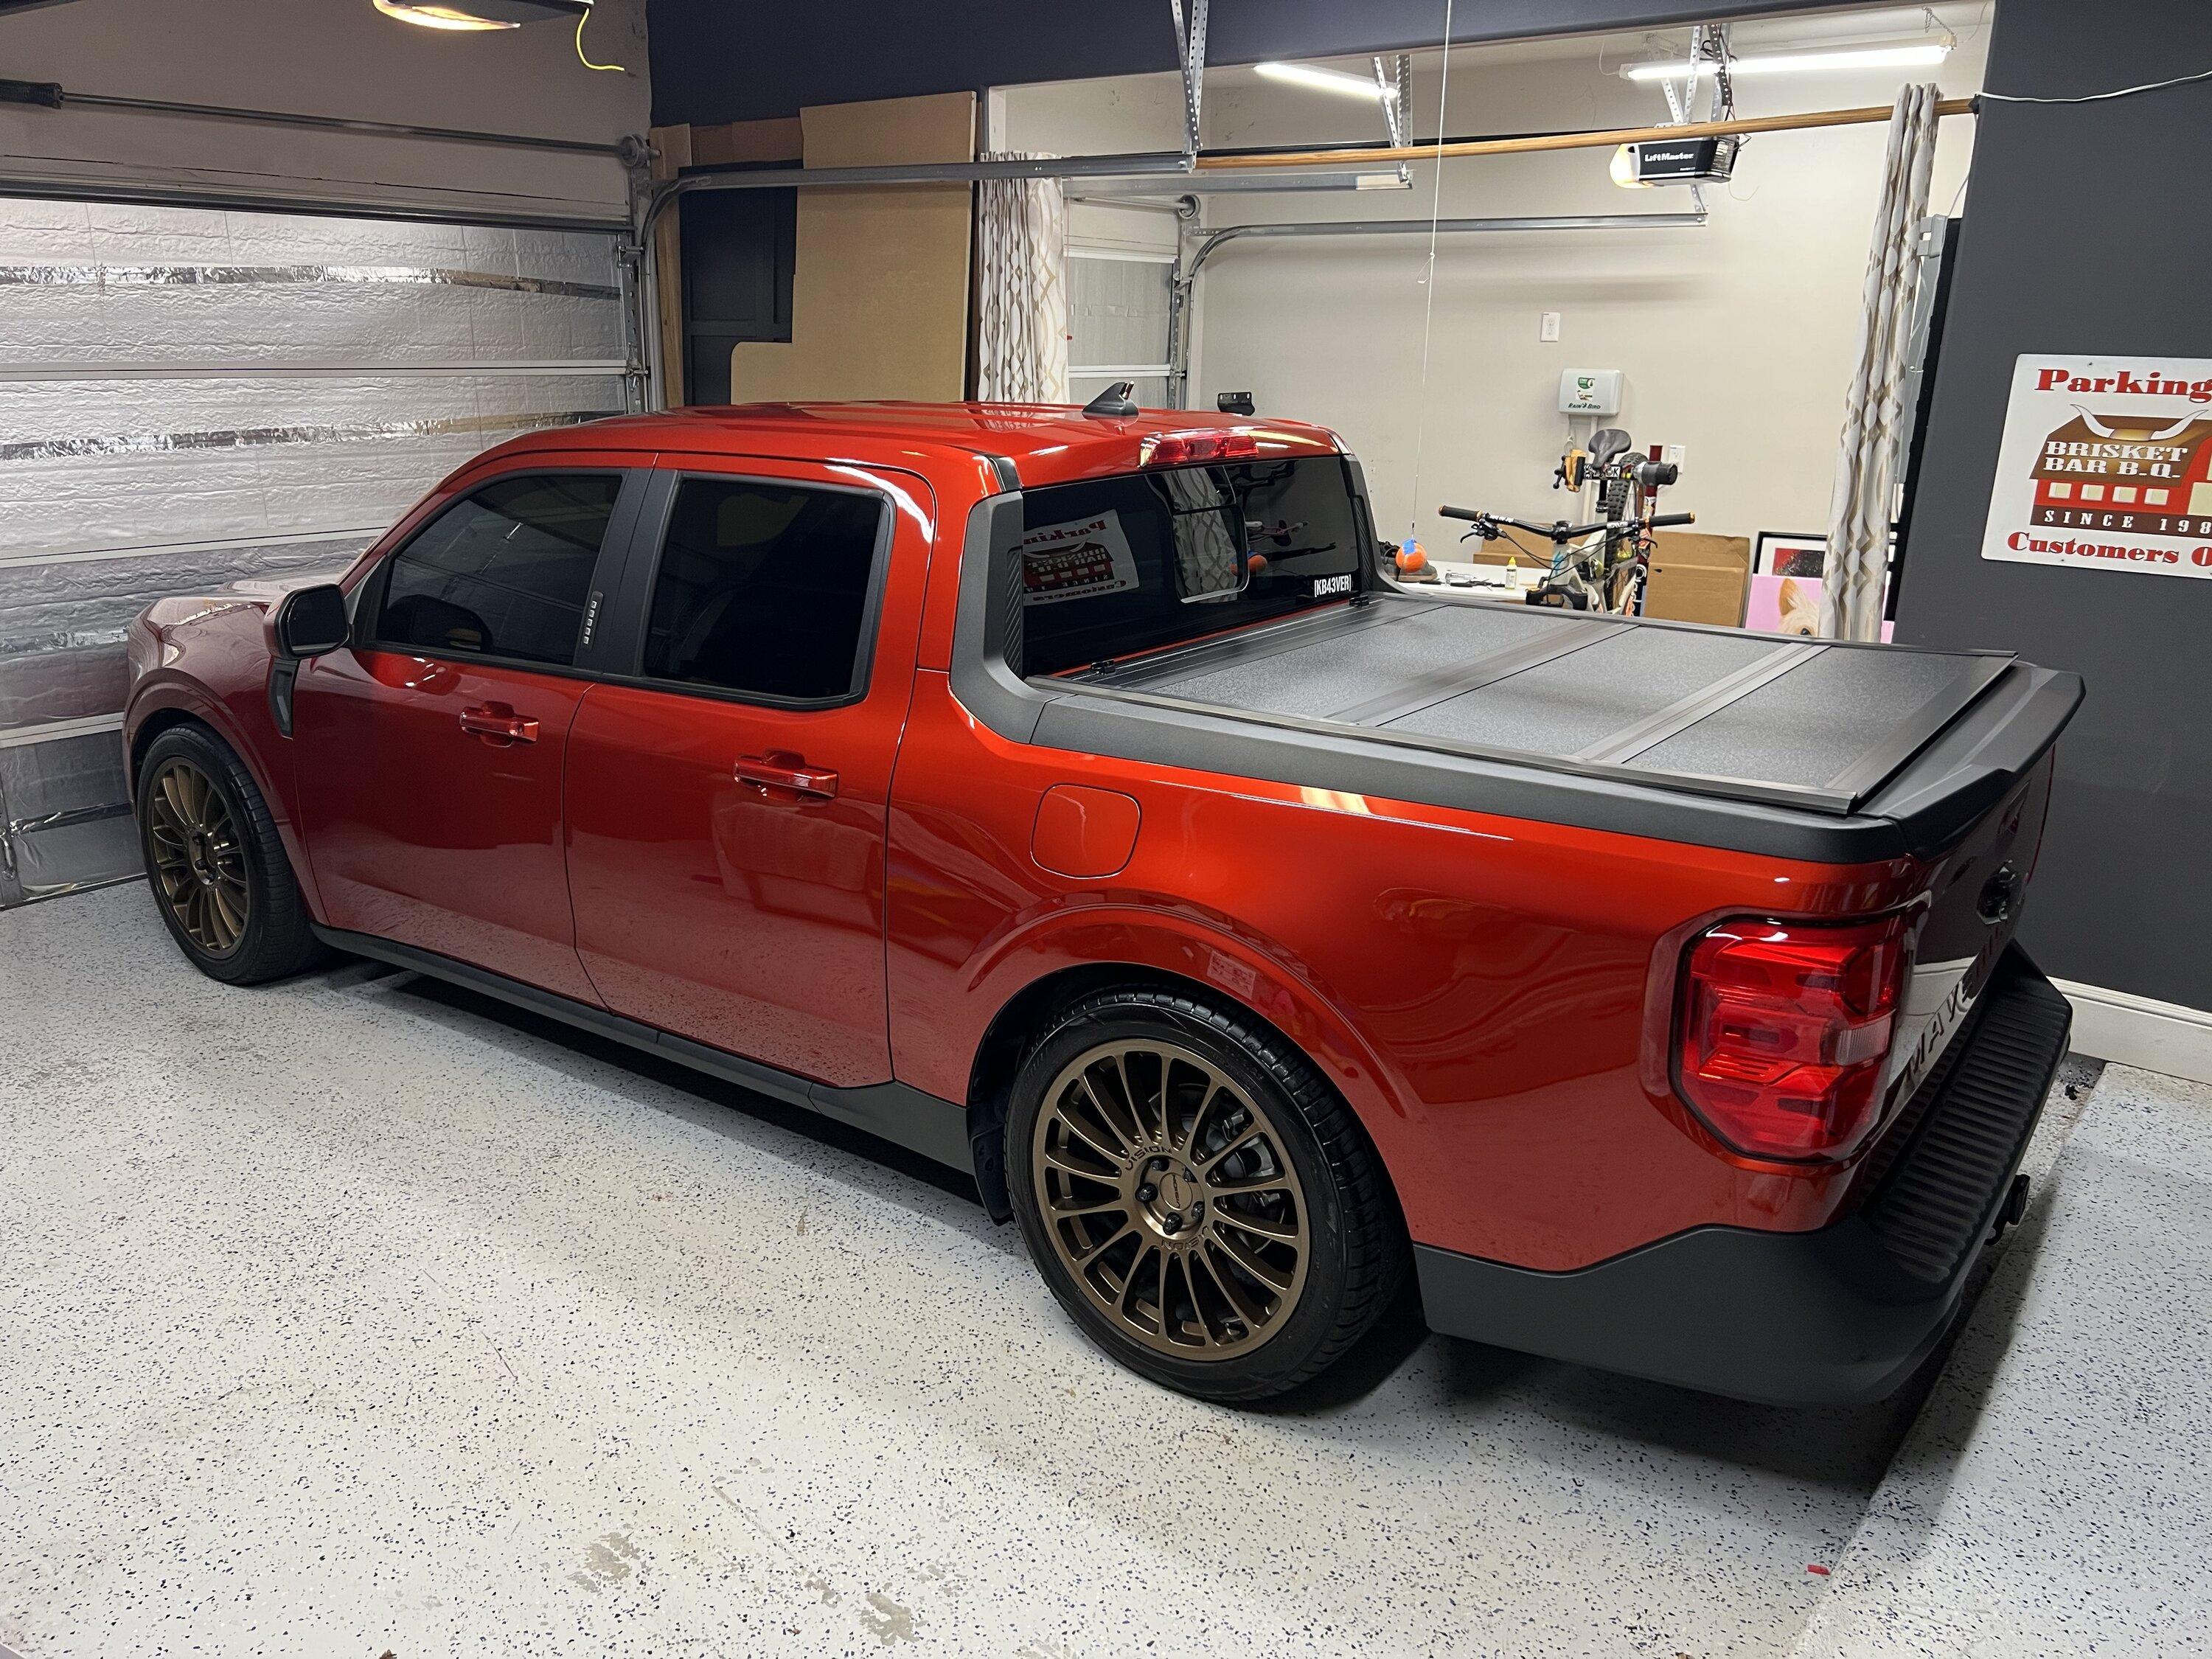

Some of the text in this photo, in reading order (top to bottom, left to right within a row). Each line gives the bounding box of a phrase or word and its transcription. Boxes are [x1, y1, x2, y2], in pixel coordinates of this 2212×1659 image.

[1644, 152, 1694, 161] LiftMaster
[2034, 369, 2212, 403] Parking
[2045, 441, 2188, 462] BRISKET
[2043, 457, 2181, 479] BAR B.Q.
[2044, 510, 2134, 528] SINCE
[2007, 532, 2179, 564] Customers
[1125, 1145, 1173, 1171] VISION
